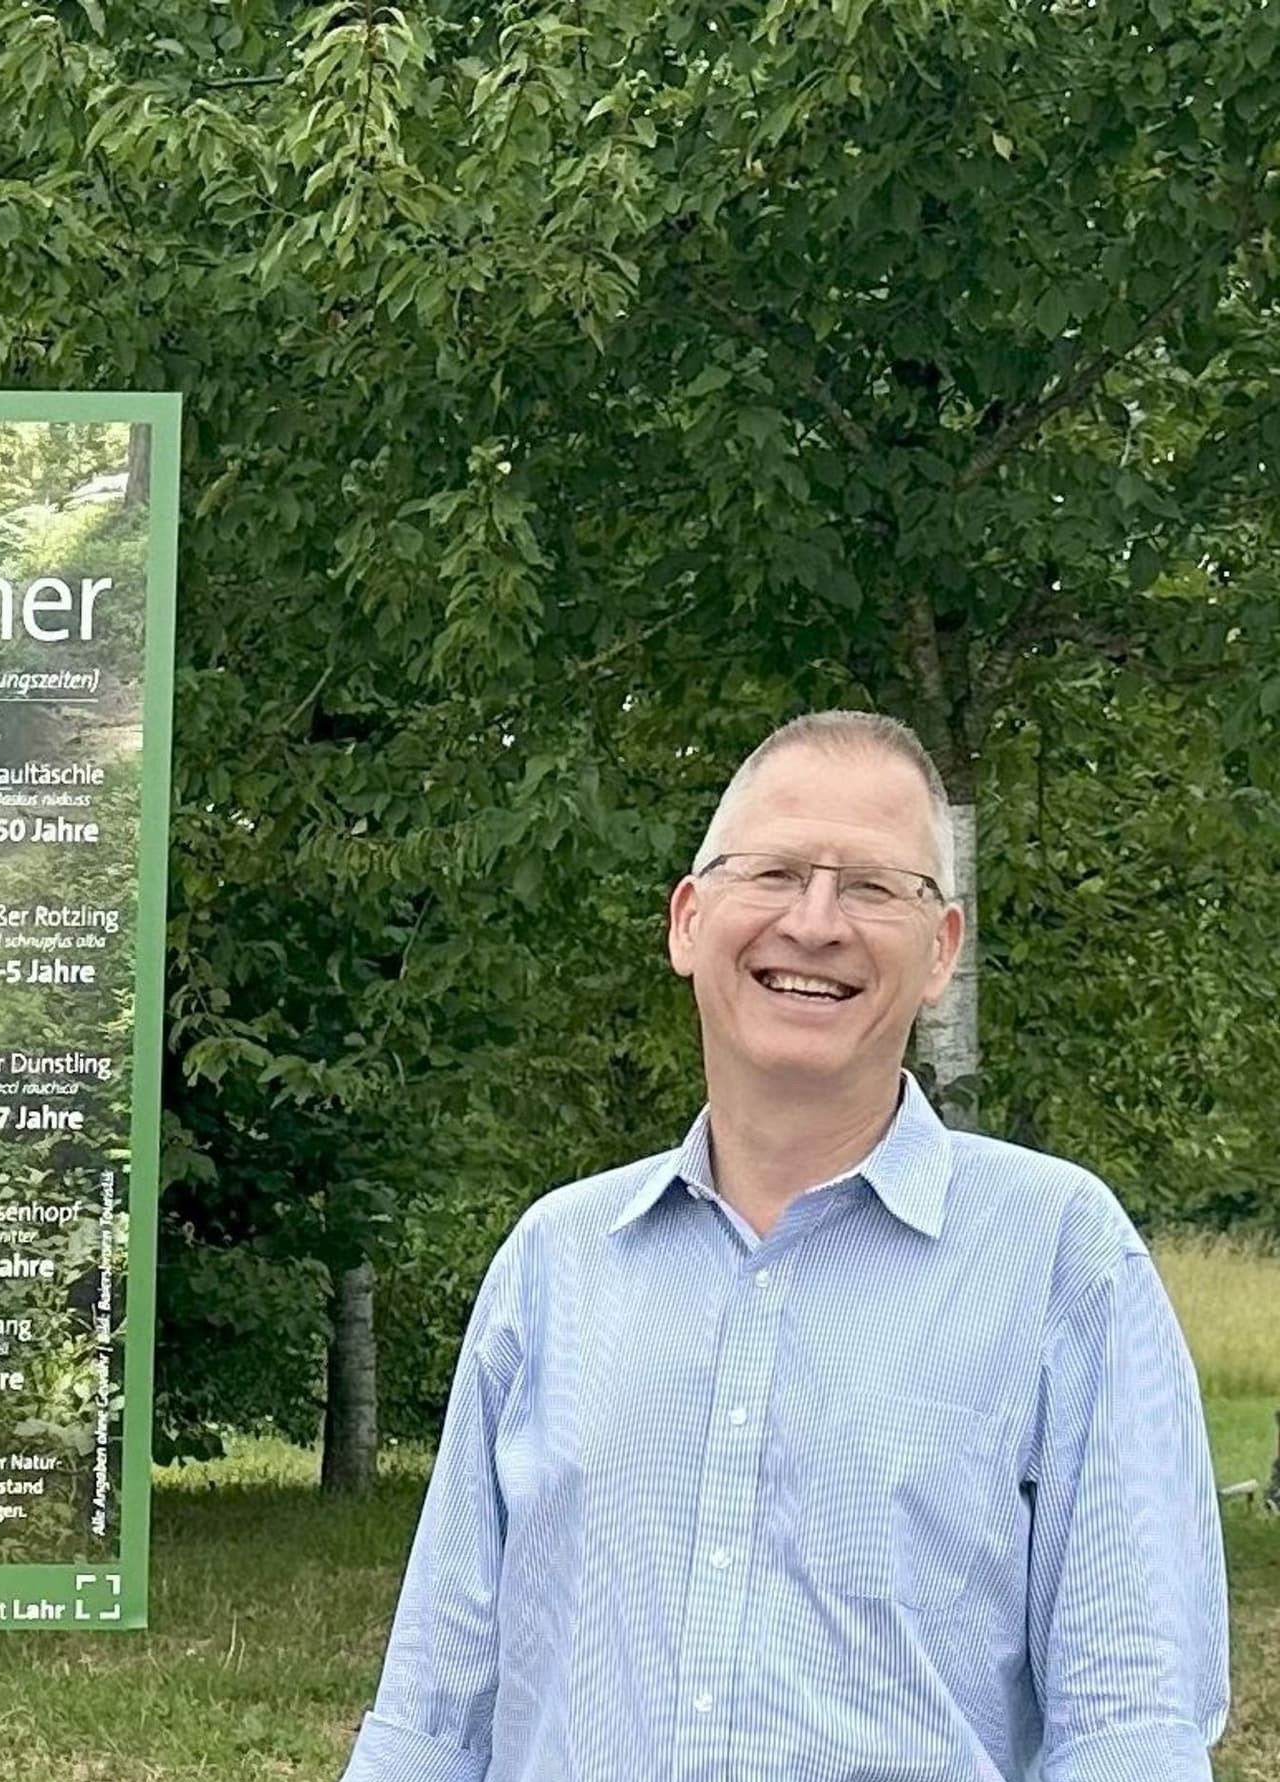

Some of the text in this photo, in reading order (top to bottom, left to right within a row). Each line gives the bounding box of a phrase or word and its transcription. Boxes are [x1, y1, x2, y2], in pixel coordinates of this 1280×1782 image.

[31, 816, 99, 842] Jahre
[35, 905, 119, 933] Rotzling
[26, 958, 96, 984] Jahre
[11, 1051, 113, 1081] Dunstling
[15, 1104, 84, 1130] Jahre
[11, 1454, 62, 1470] Natur-
[12, 1599, 65, 1620] Lahr
